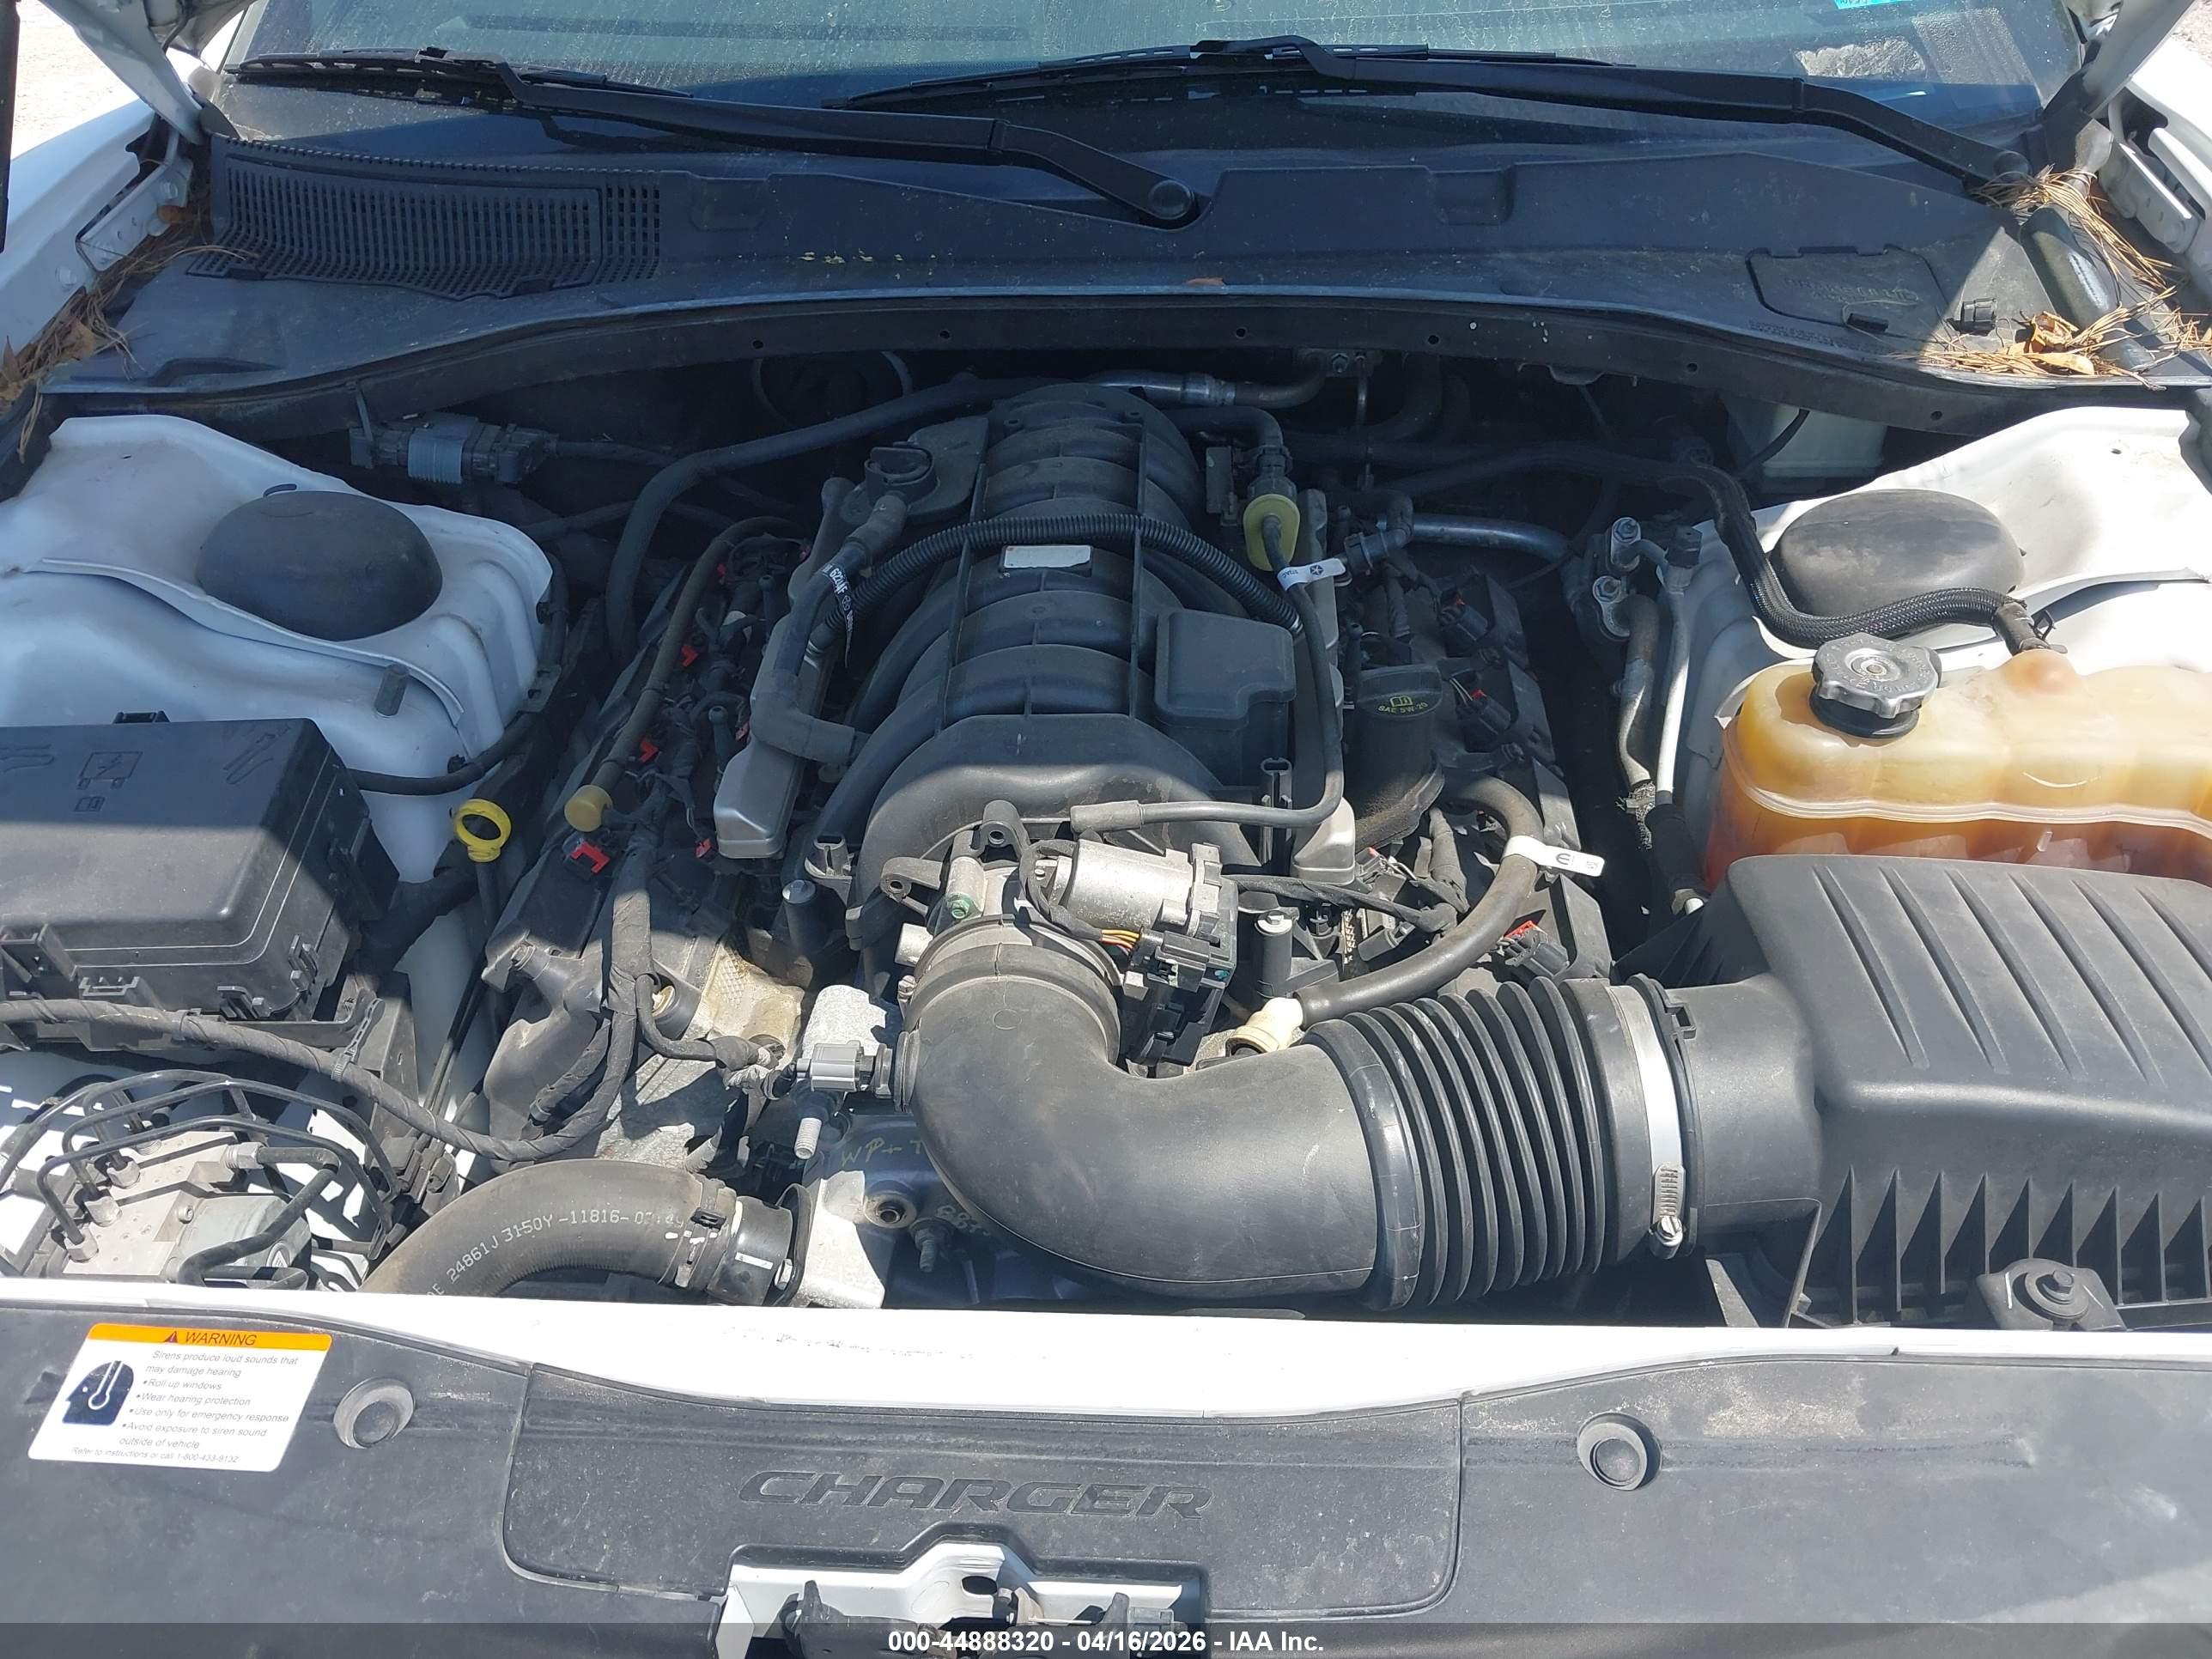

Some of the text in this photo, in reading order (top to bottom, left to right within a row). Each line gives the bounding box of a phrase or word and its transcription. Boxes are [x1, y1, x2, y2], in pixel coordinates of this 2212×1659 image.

[185, 1331, 258, 1346] WARNING
[152, 1350, 299, 1365] Sirens produce loud sounds that
[145, 1365, 242, 1378] may damage hearing
[148, 1378, 222, 1390] Roll up windows
[141, 1392, 251, 1406] Wear hearing protection
[134, 1407, 289, 1423] Use only for emergency response
[126, 1421, 153, 1431] Avoid
[155, 1425, 198, 1434] exposure
[212, 1427, 238, 1436] siren
[118, 1437, 200, 1449] outside of vehicle
[738, 1470, 1215, 1519] CHARGER
